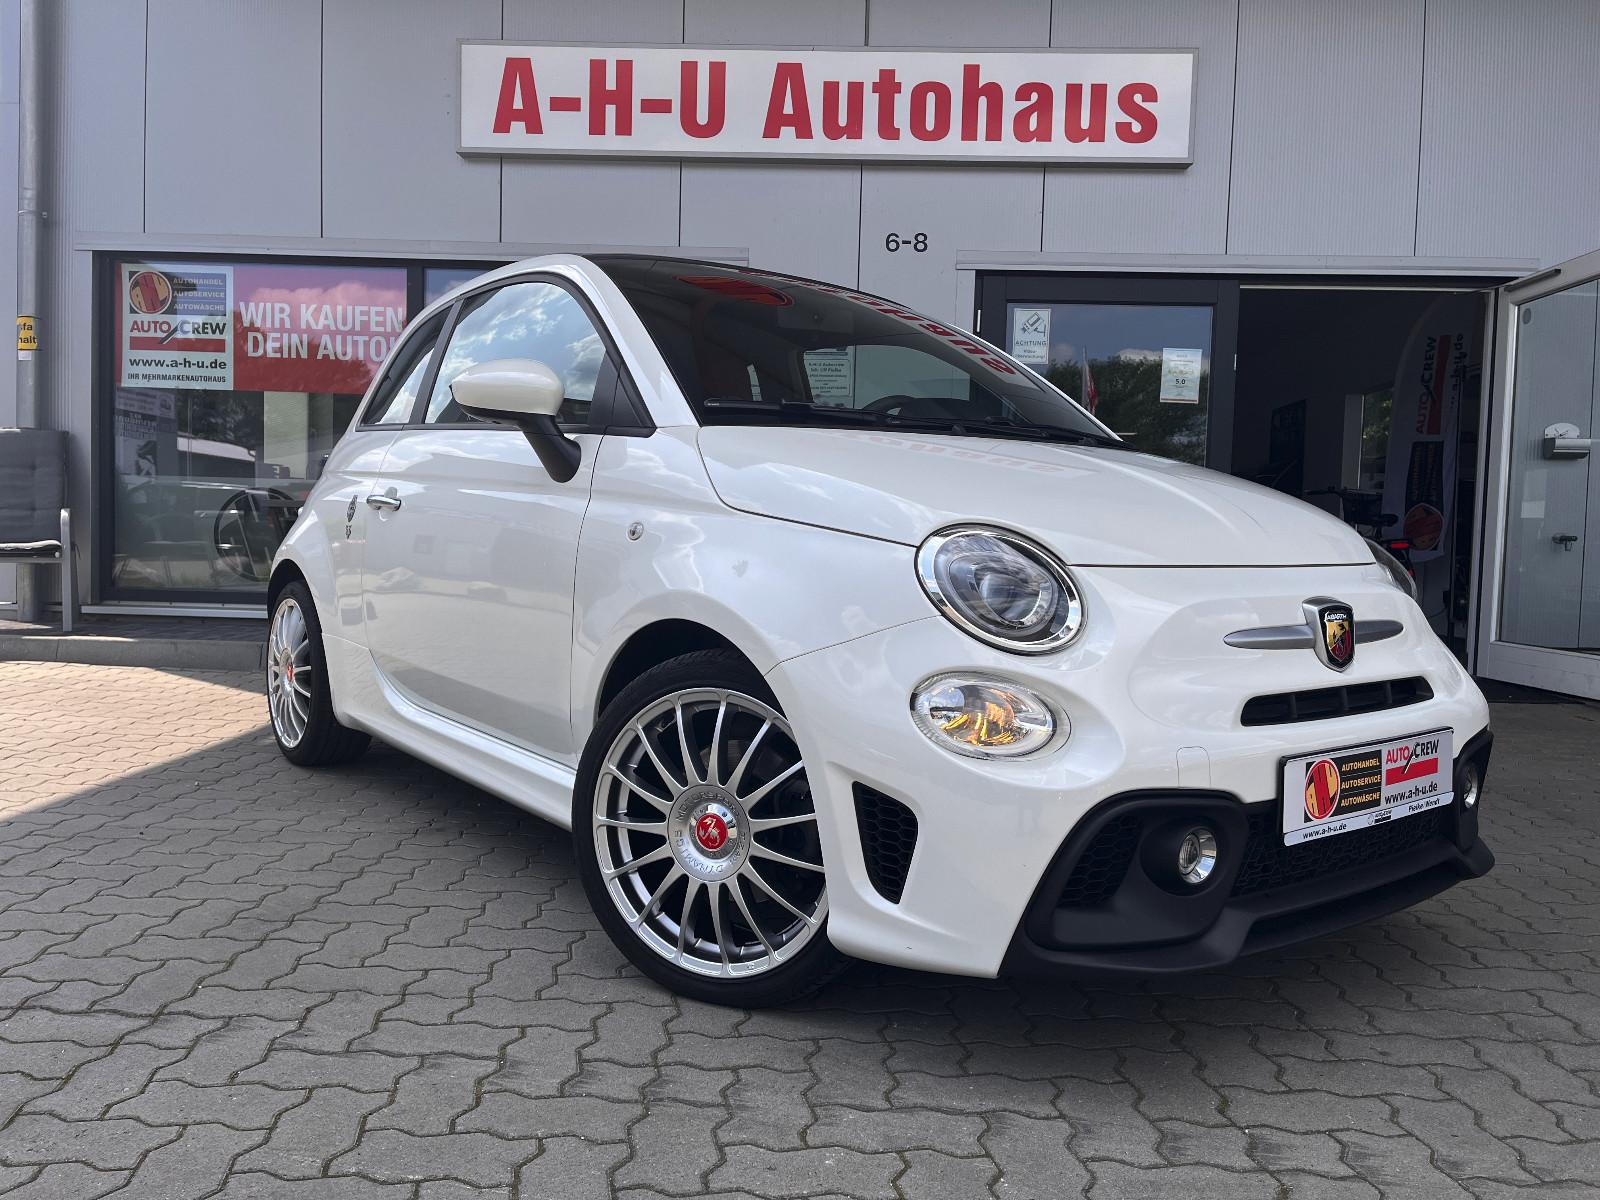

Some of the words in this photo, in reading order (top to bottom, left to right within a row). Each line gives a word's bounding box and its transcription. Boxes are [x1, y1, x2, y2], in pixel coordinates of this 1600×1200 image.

[493, 57, 727, 139] A-H-U
[762, 62, 1159, 144] Autohaus
[886, 232, 928, 252] 6-8
[173, 277, 224, 285] AUTOHANDEL
[239, 301, 291, 329] WIR
[300, 303, 404, 333] KAUFEN
[247, 332, 309, 359] DEIN
[129, 358, 227, 370] www.a-h-u.de
[141, 374, 227, 383] MEHRMARKENAUTOHAUS
[1341, 758, 1380, 772] AUTOHANDEL
[1341, 774, 1381, 790] AUTOSERVICE
[1341, 791, 1380, 807] AUTOWÄSCHE
[1384, 781, 1438, 805] www.a-h-u.de
[1302, 822, 1347, 840] www.a-h-u.de
